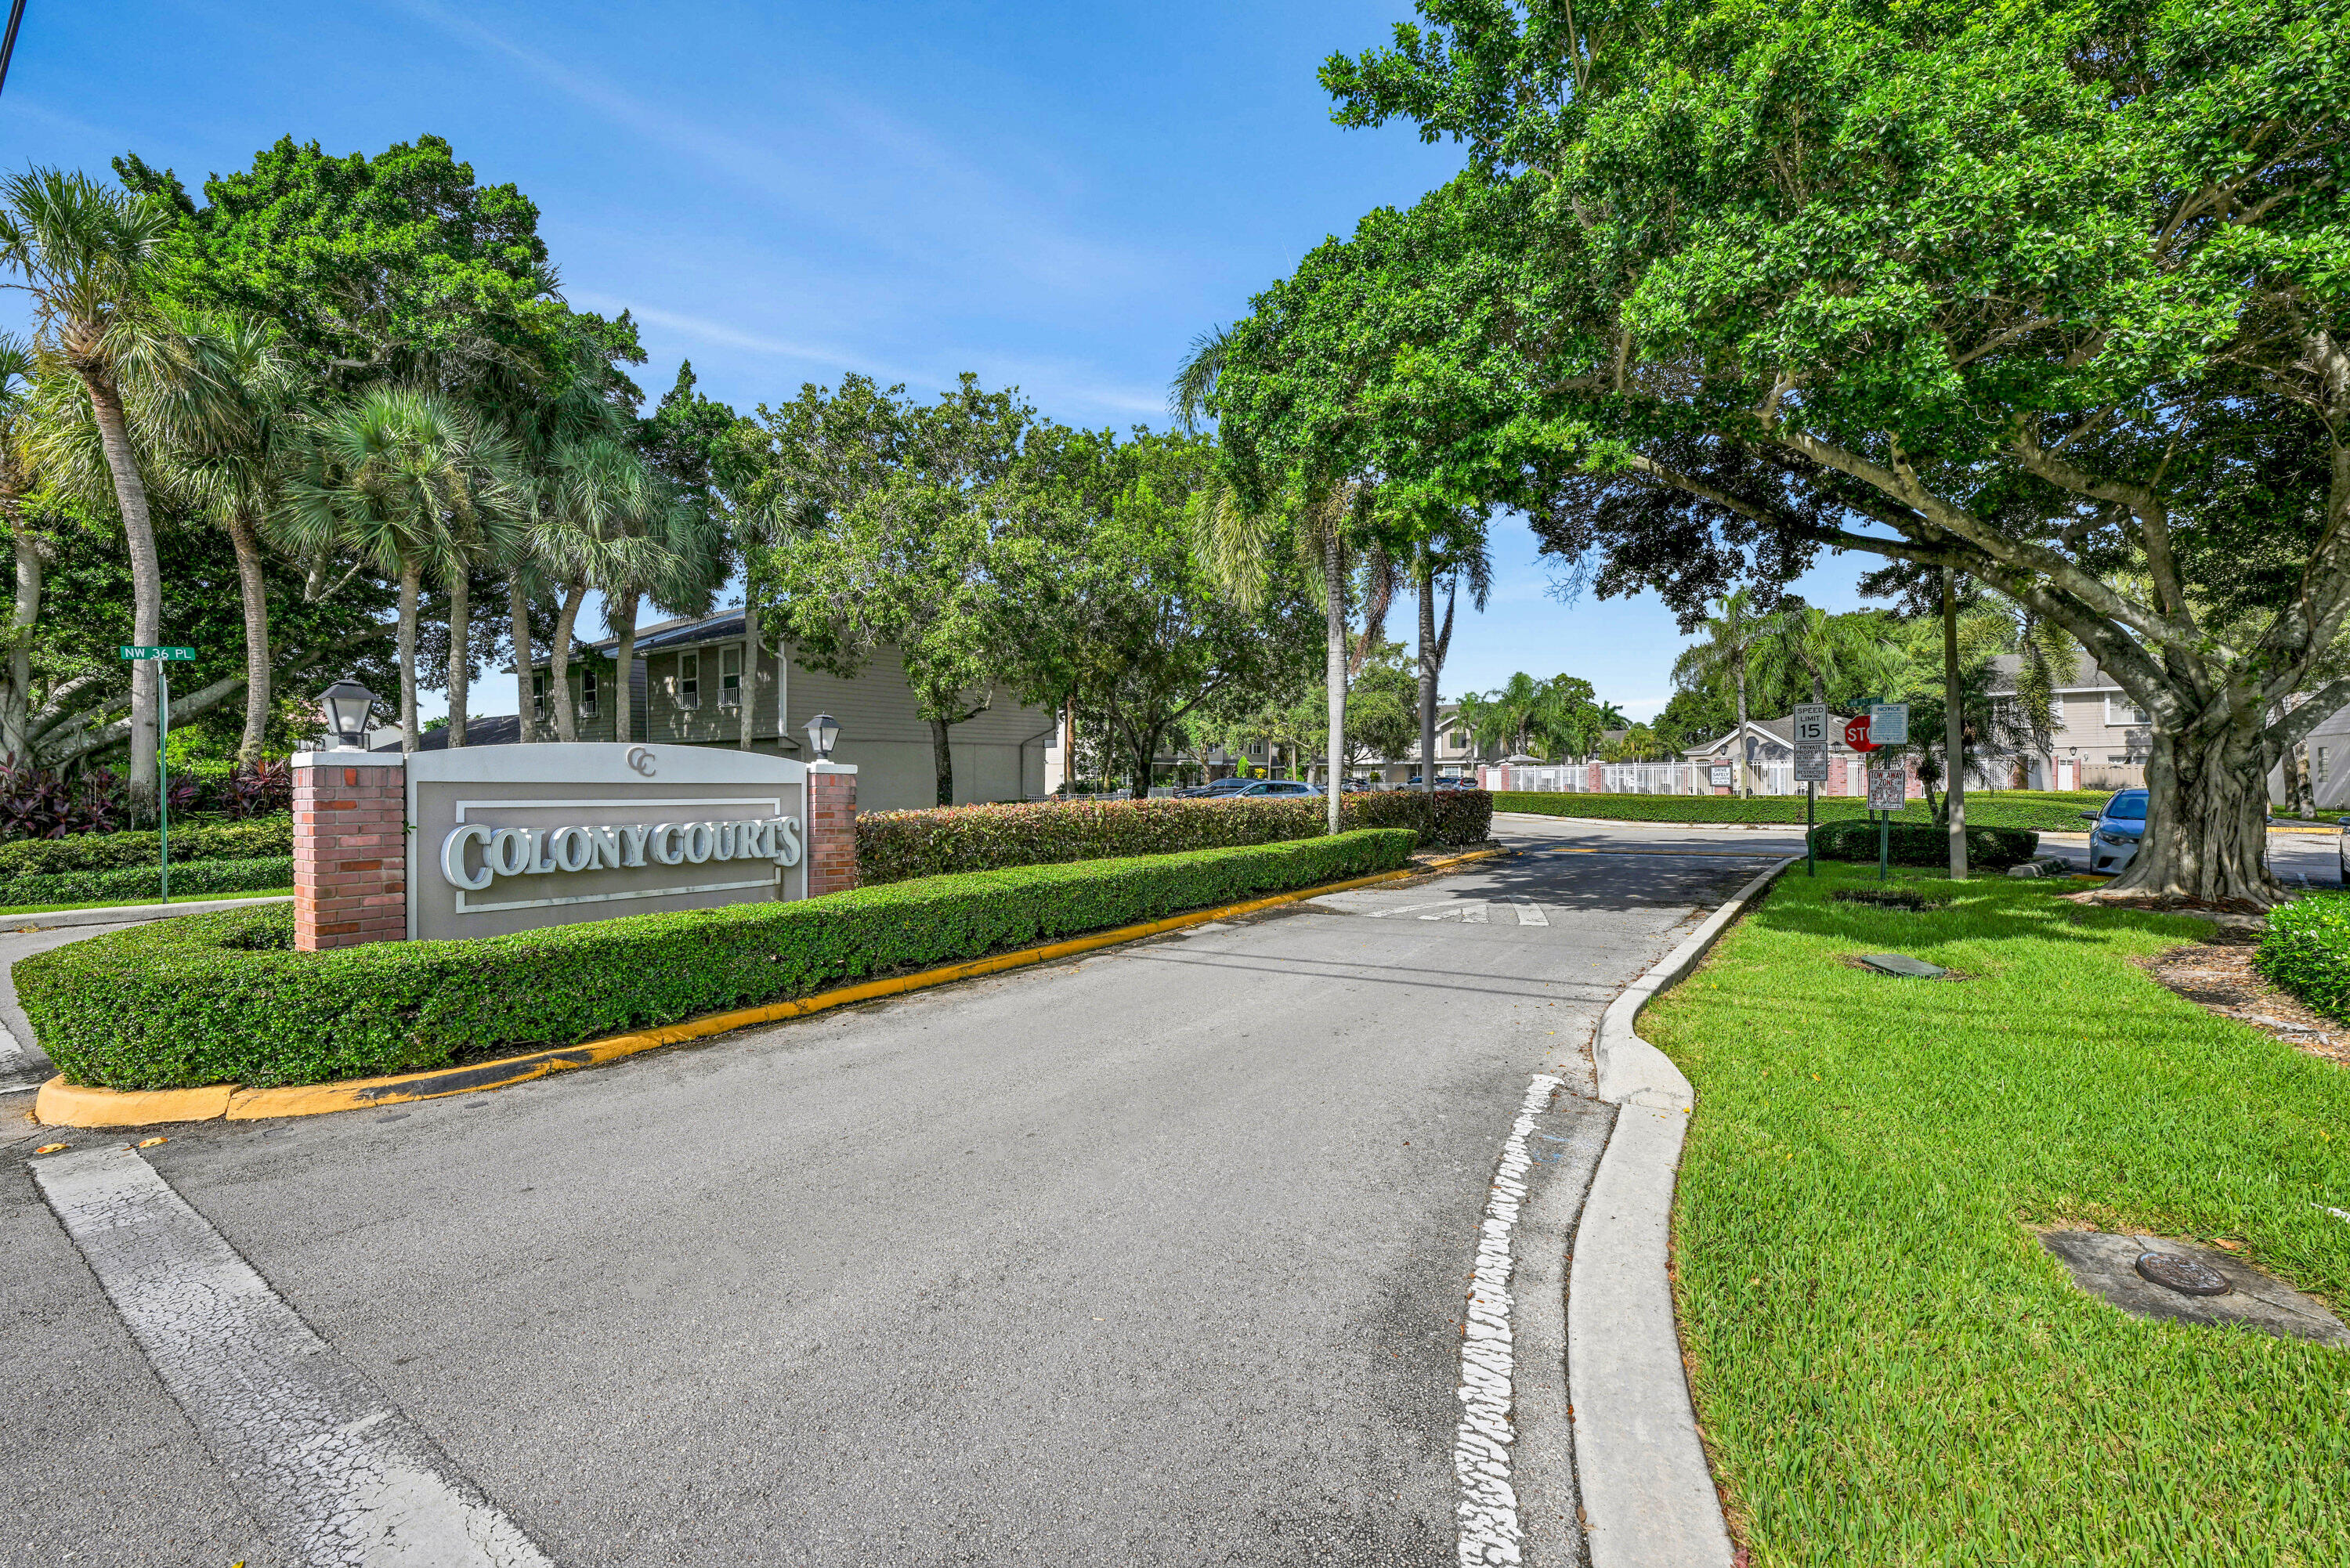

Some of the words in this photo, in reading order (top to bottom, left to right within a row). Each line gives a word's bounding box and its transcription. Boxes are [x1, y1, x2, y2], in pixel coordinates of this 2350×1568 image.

[125, 648, 145, 658] NW
[152, 649, 169, 659] 36
[175, 649, 192, 659] PL
[1800, 724, 1820, 738] 15
[1848, 727, 1871, 742] ST
[627, 746, 656, 777] CC
